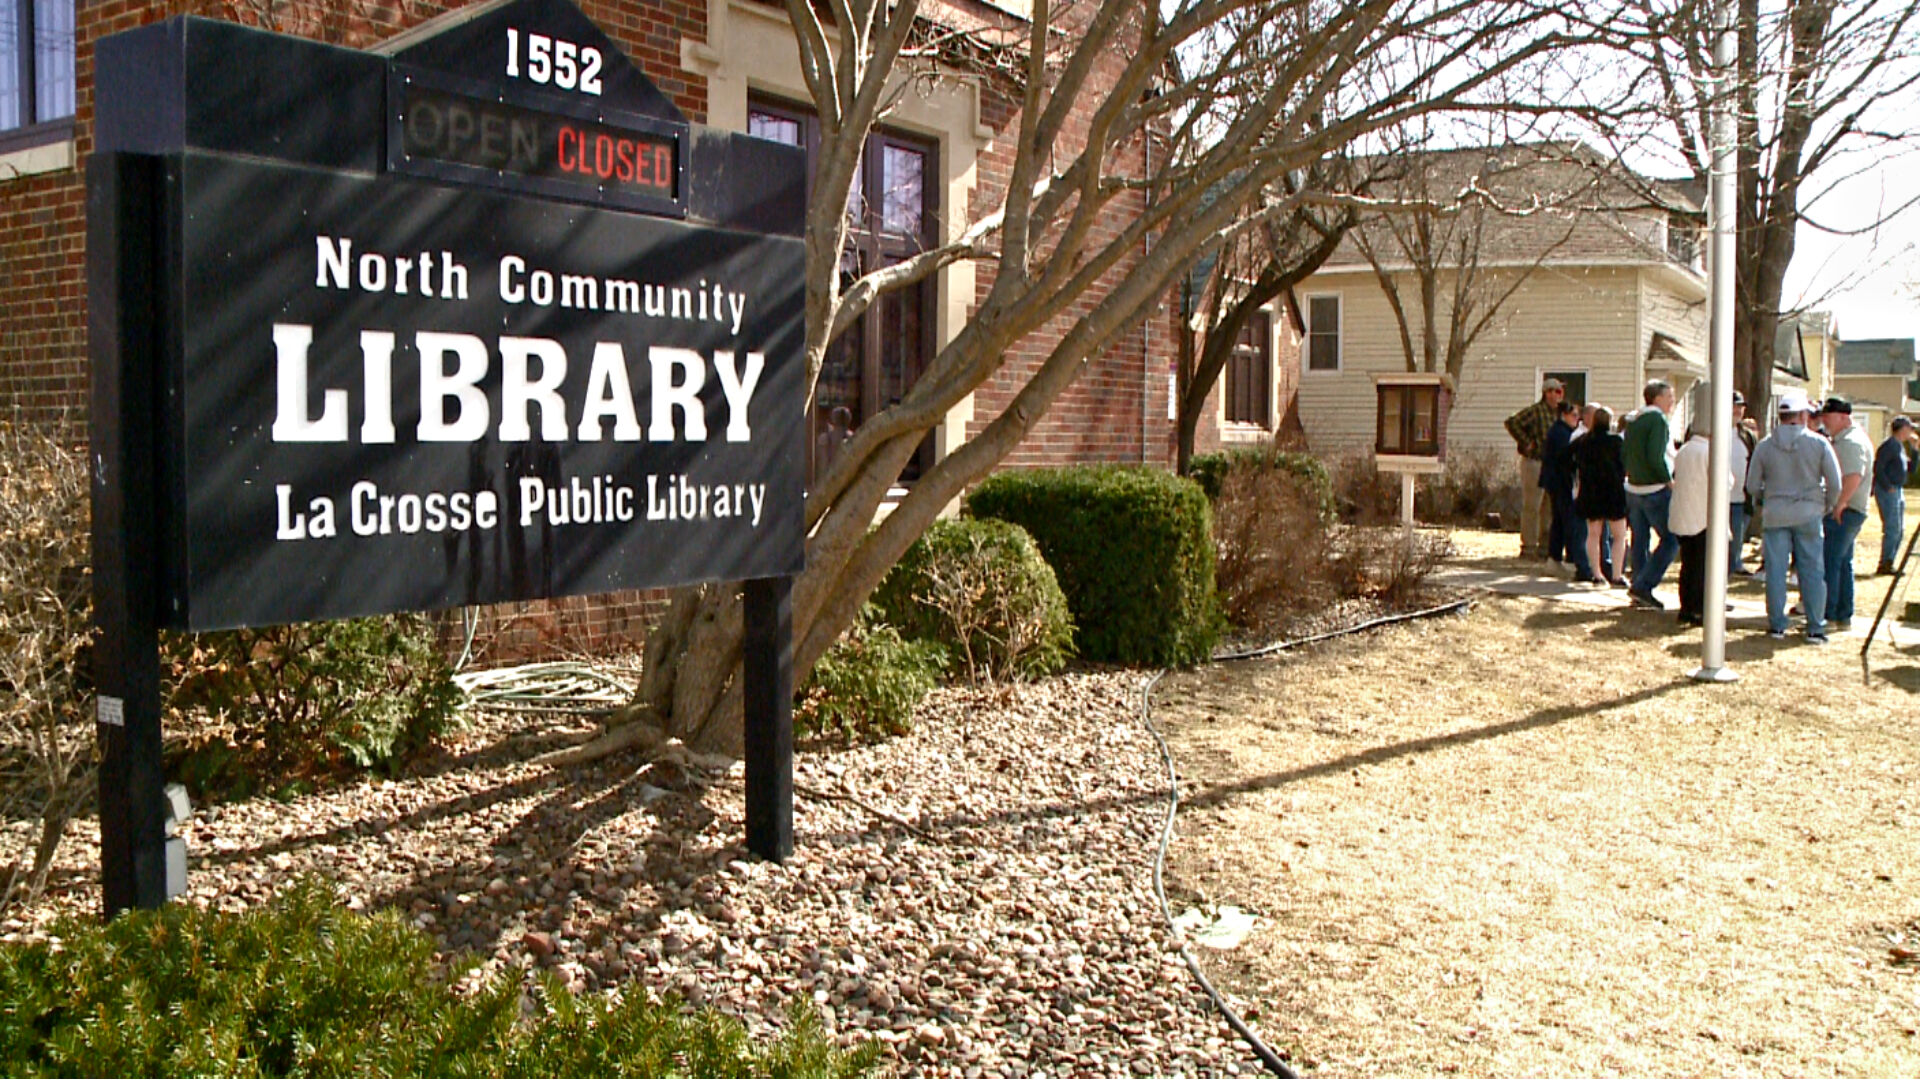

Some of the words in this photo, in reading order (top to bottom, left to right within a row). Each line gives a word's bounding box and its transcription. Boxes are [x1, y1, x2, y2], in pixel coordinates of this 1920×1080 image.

[506, 27, 602, 96] 1552
[408, 102, 539, 167] OPEN
[557, 126, 673, 188] CLOSED
[316, 235, 469, 300] North
[499, 255, 746, 335] Community
[272, 323, 765, 443] LIBRARY
[276, 484, 336, 540] La
[351, 481, 497, 536] Crosse
[519, 474, 634, 527] Public
[646, 474, 766, 527] Library
